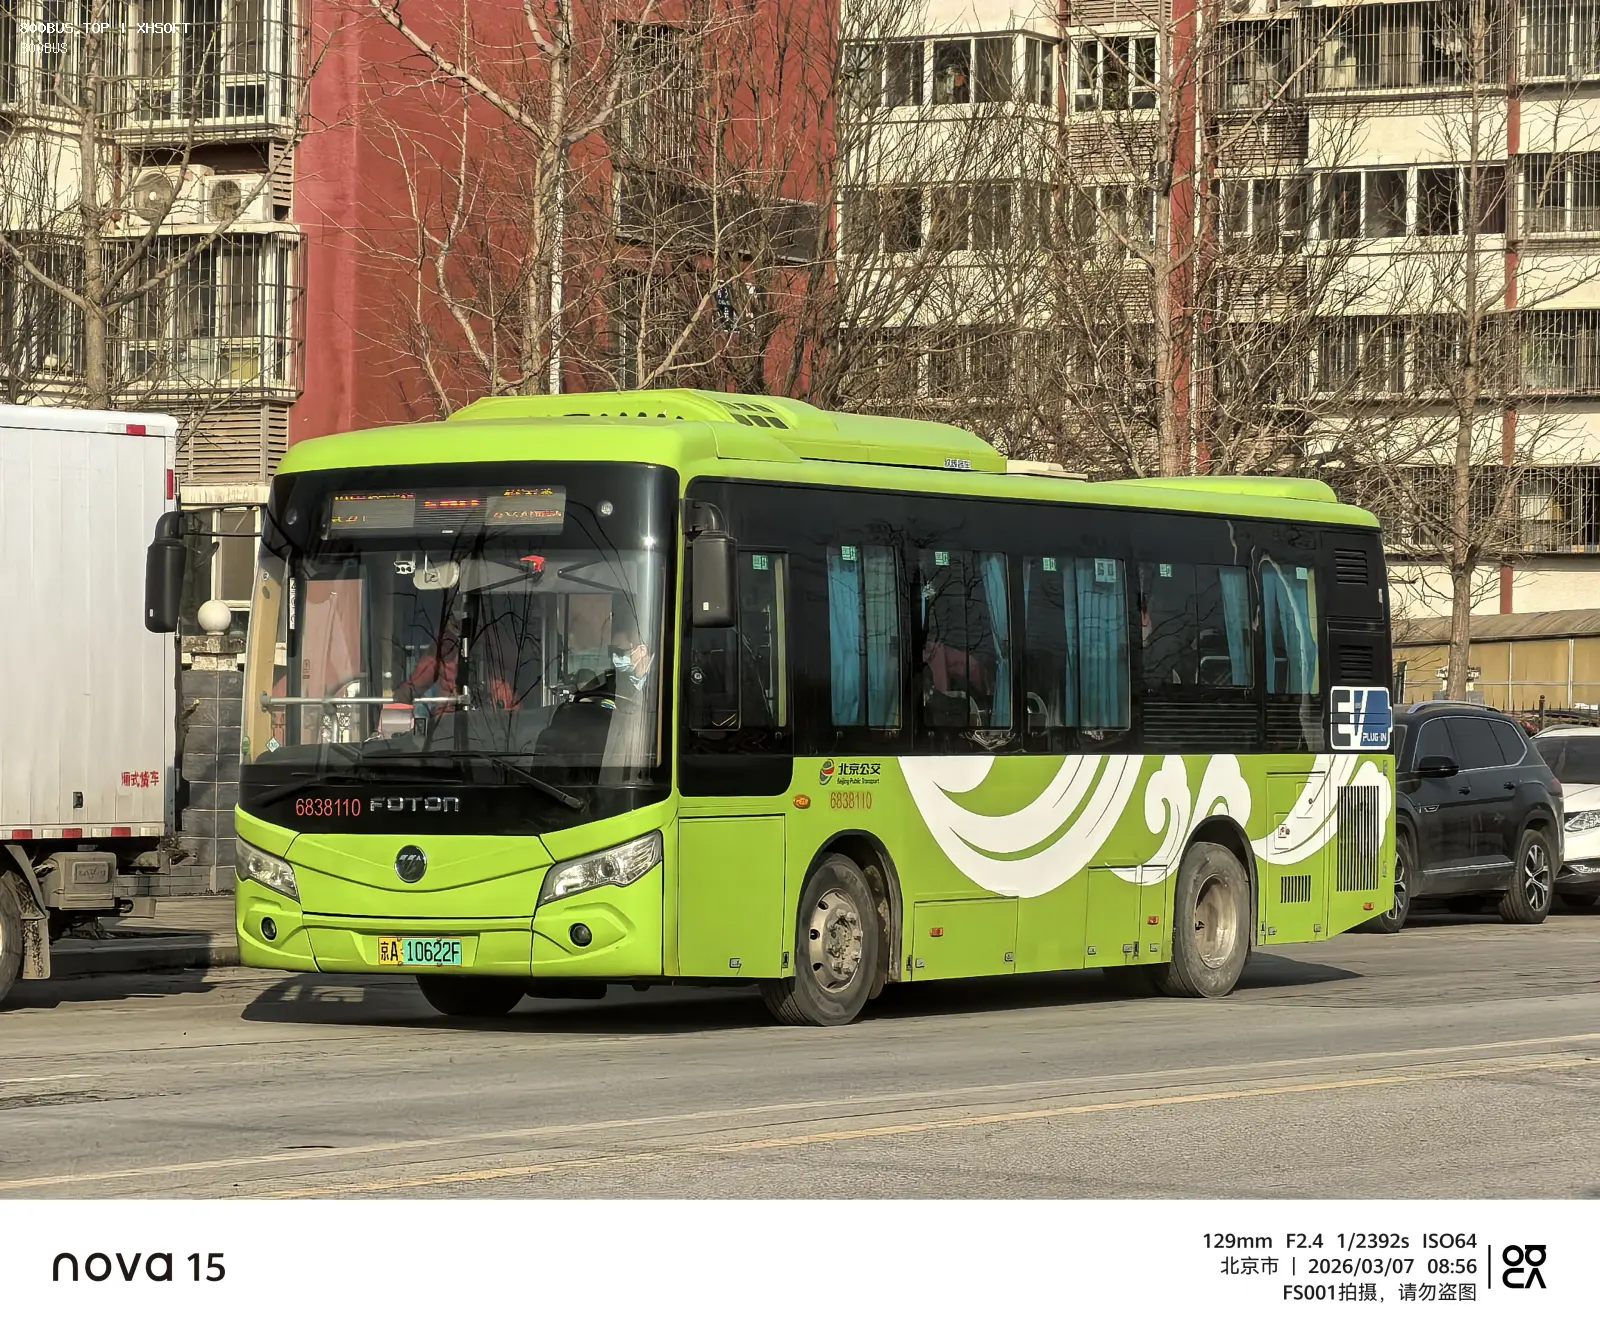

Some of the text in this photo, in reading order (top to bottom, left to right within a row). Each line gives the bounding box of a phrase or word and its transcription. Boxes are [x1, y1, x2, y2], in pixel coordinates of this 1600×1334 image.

[838, 763, 881, 775] 北京公交
[295, 798, 361, 817] 6838110
[370, 797, 459, 812] FOTON
[830, 791, 872, 809] 6838110
[380, 941, 460, 962] 京A 10622F
